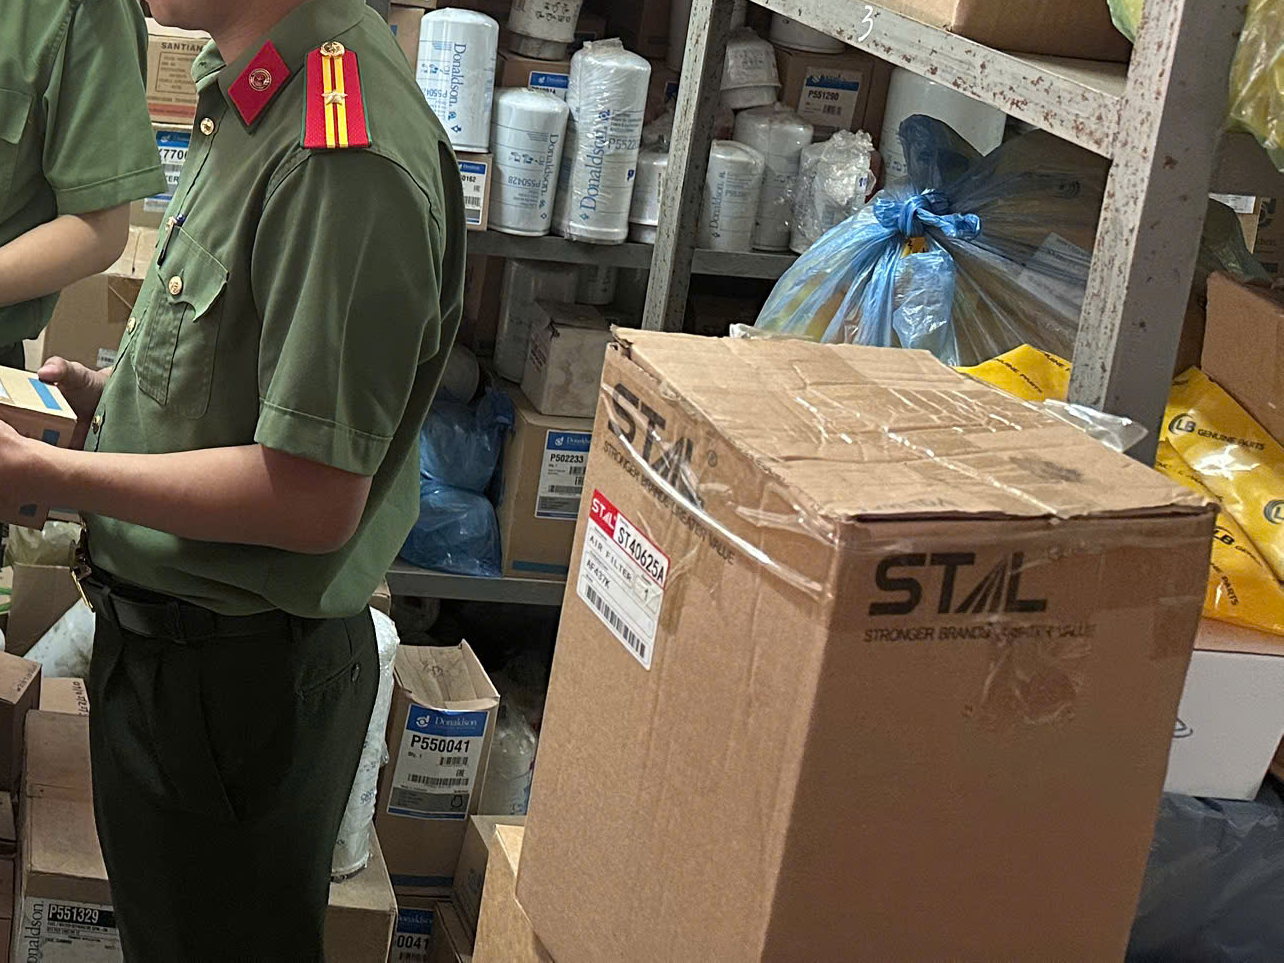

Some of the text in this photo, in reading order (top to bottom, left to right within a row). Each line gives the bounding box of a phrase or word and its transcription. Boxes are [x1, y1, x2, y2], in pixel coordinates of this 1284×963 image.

[857, 4, 874, 43] 3
[461, 175, 476, 183] 0162
[507, 175, 542, 188] P550428
[1197, 428, 1237, 445] GENUINE
[1238, 438, 1266, 451] PARTS
[549, 453, 584, 464] P502233
[591, 497, 616, 531] STAL
[589, 535, 633, 582] AIR FILTER
[617, 526, 665, 583] ST40625A
[586, 559, 610, 589] AF437K
[868, 550, 1049, 617] STAL
[863, 627, 934, 643] STRONGER
[410, 734, 471, 754] P550041
[48, 903, 100, 925] P551329
[396, 934, 429, 950] 0041
